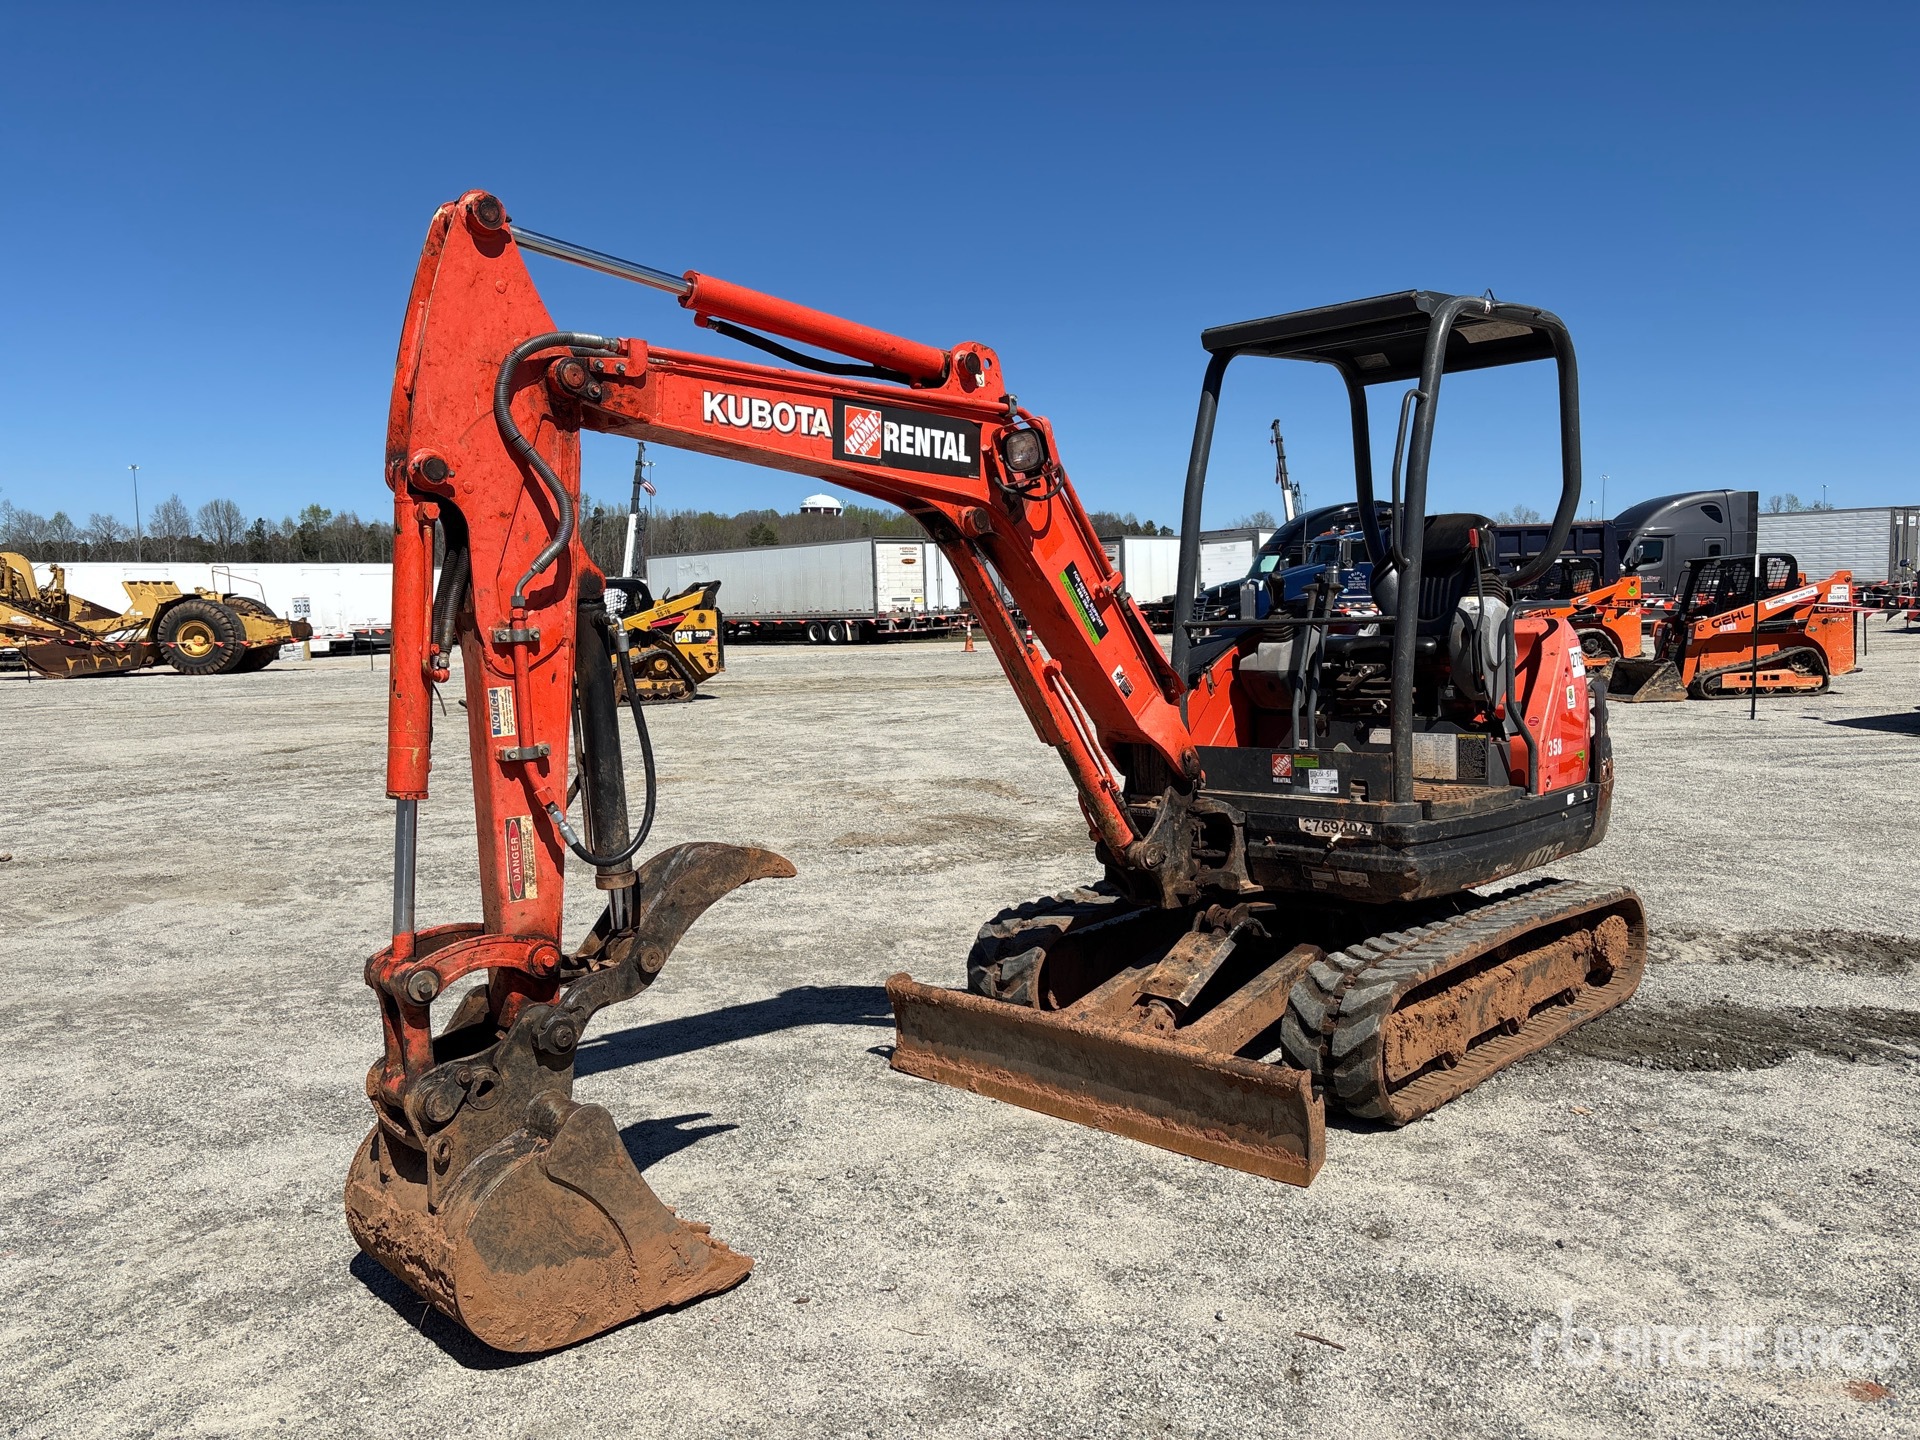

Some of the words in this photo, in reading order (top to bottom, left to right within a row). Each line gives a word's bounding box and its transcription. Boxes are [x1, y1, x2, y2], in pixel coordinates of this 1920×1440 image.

[703, 391, 832, 437] KUBOTA
[848, 413, 864, 431] THE
[845, 410, 881, 454] HOME
[860, 428, 881, 455] DEPOT
[883, 420, 972, 463] RENTAL
[1072, 570, 1081, 583] FOR
[1079, 582, 1092, 604] RENTAL
[1089, 601, 1104, 628] SUPPORT
[1711, 611, 1751, 628] GEHL
[675, 631, 693, 643] CAT
[490, 691, 500, 730] NOTICE
[1548, 739, 1562, 757] 358
[1272, 755, 1291, 775] HOME
[510, 837, 521, 881] DANGER
